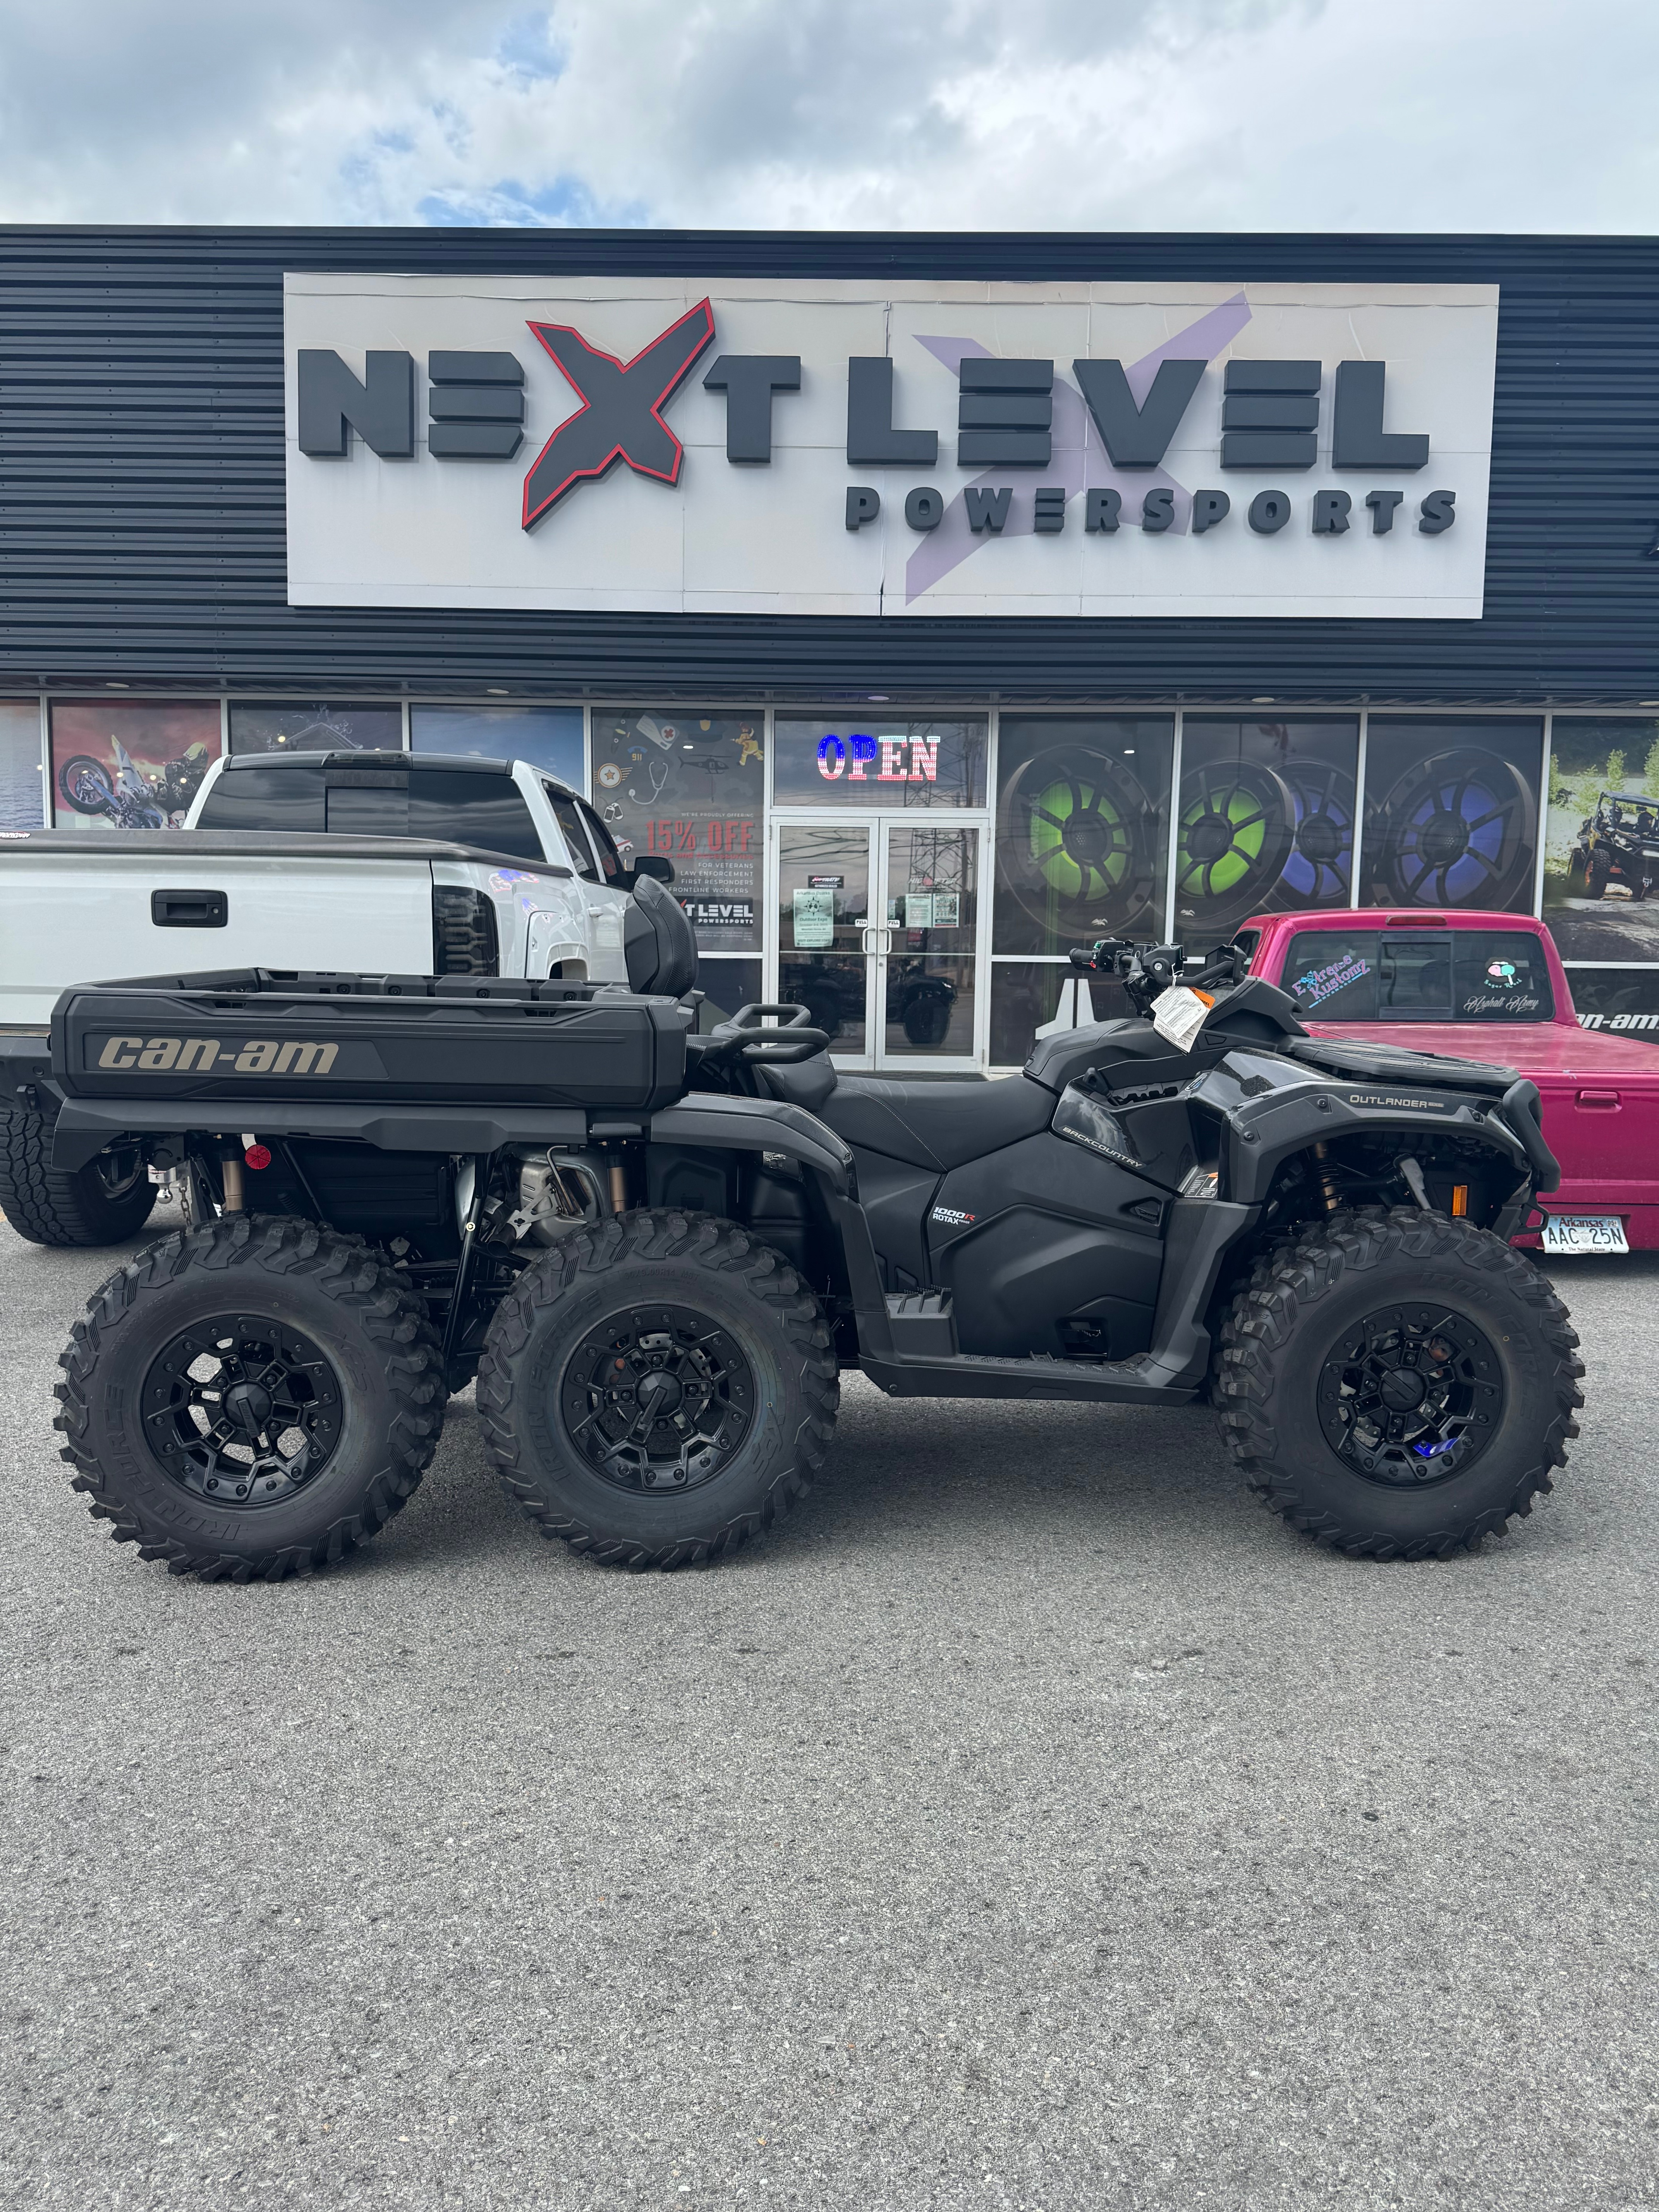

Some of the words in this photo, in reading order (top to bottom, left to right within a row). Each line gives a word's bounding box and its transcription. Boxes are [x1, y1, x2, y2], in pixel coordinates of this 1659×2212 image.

[298, 296, 802, 533] NEXT
[847, 356, 1430, 469] LEVEL
[845, 486, 1456, 534] POWERSPORTS
[817, 734, 941, 781] OPEN
[646, 820, 696, 850] 15%
[708, 821, 754, 851] OFF
[1028, 793, 1041, 864] Kawasaki
[698, 904, 753, 917] LEVEL
[1506, 994, 1539, 1014] Army
[99, 1036, 339, 1074] can-am
[1350, 1094, 1427, 1108] OUTLANDER
[1062, 1127, 1142, 1167] BACKCOUNTRY
[933, 1213, 959, 1225] ROTAX
[934, 1207, 975, 1221] 1000R
[1559, 1217, 1604, 1227] Arkansas
[1549, 1227, 1579, 1244] AAC
[1589, 1228, 1623, 1245] 25N
[104, 1383, 155, 1495] FORCE
[527, 1405, 570, 1481] IRON
[154, 1499, 241, 1540] IRON
